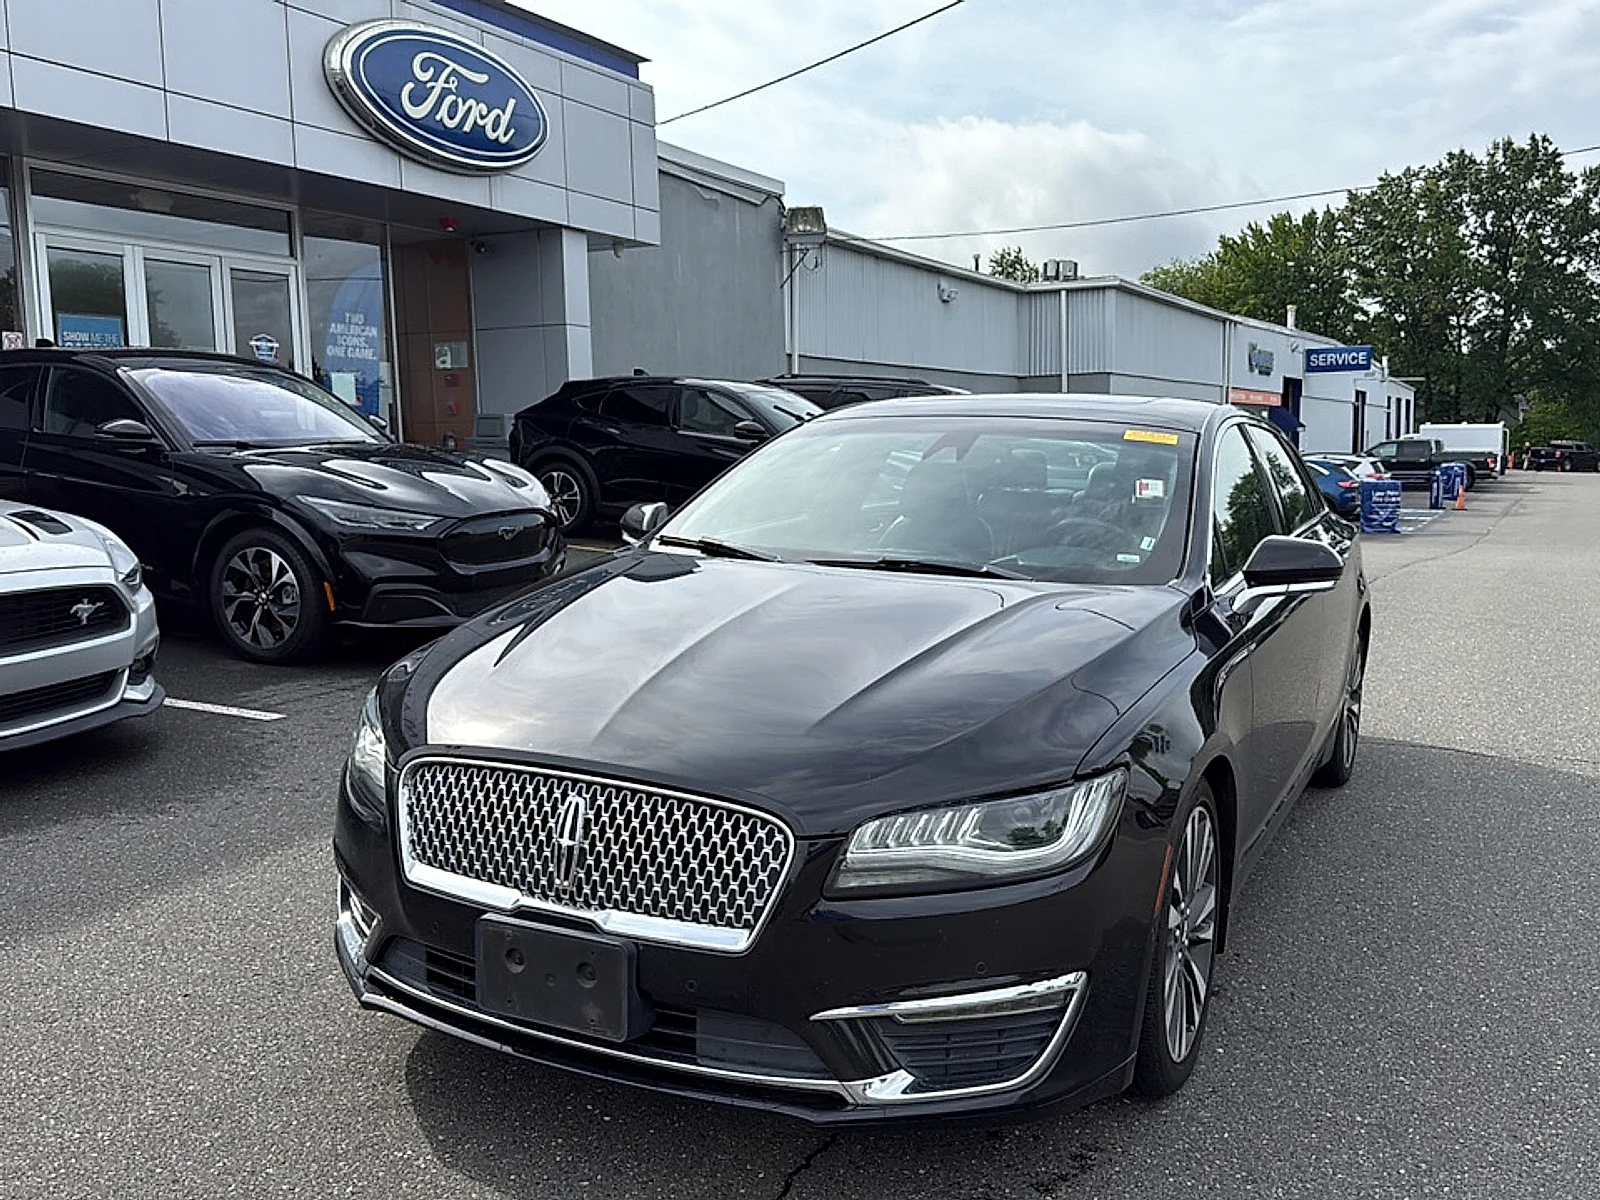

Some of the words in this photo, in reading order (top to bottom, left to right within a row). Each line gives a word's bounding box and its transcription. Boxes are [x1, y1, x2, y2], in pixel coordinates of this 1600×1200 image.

[401, 52, 516, 144] Ford
[63, 331, 90, 342] SHOW
[326, 344, 346, 357] ONE
[1310, 352, 1367, 367] SERVICE
